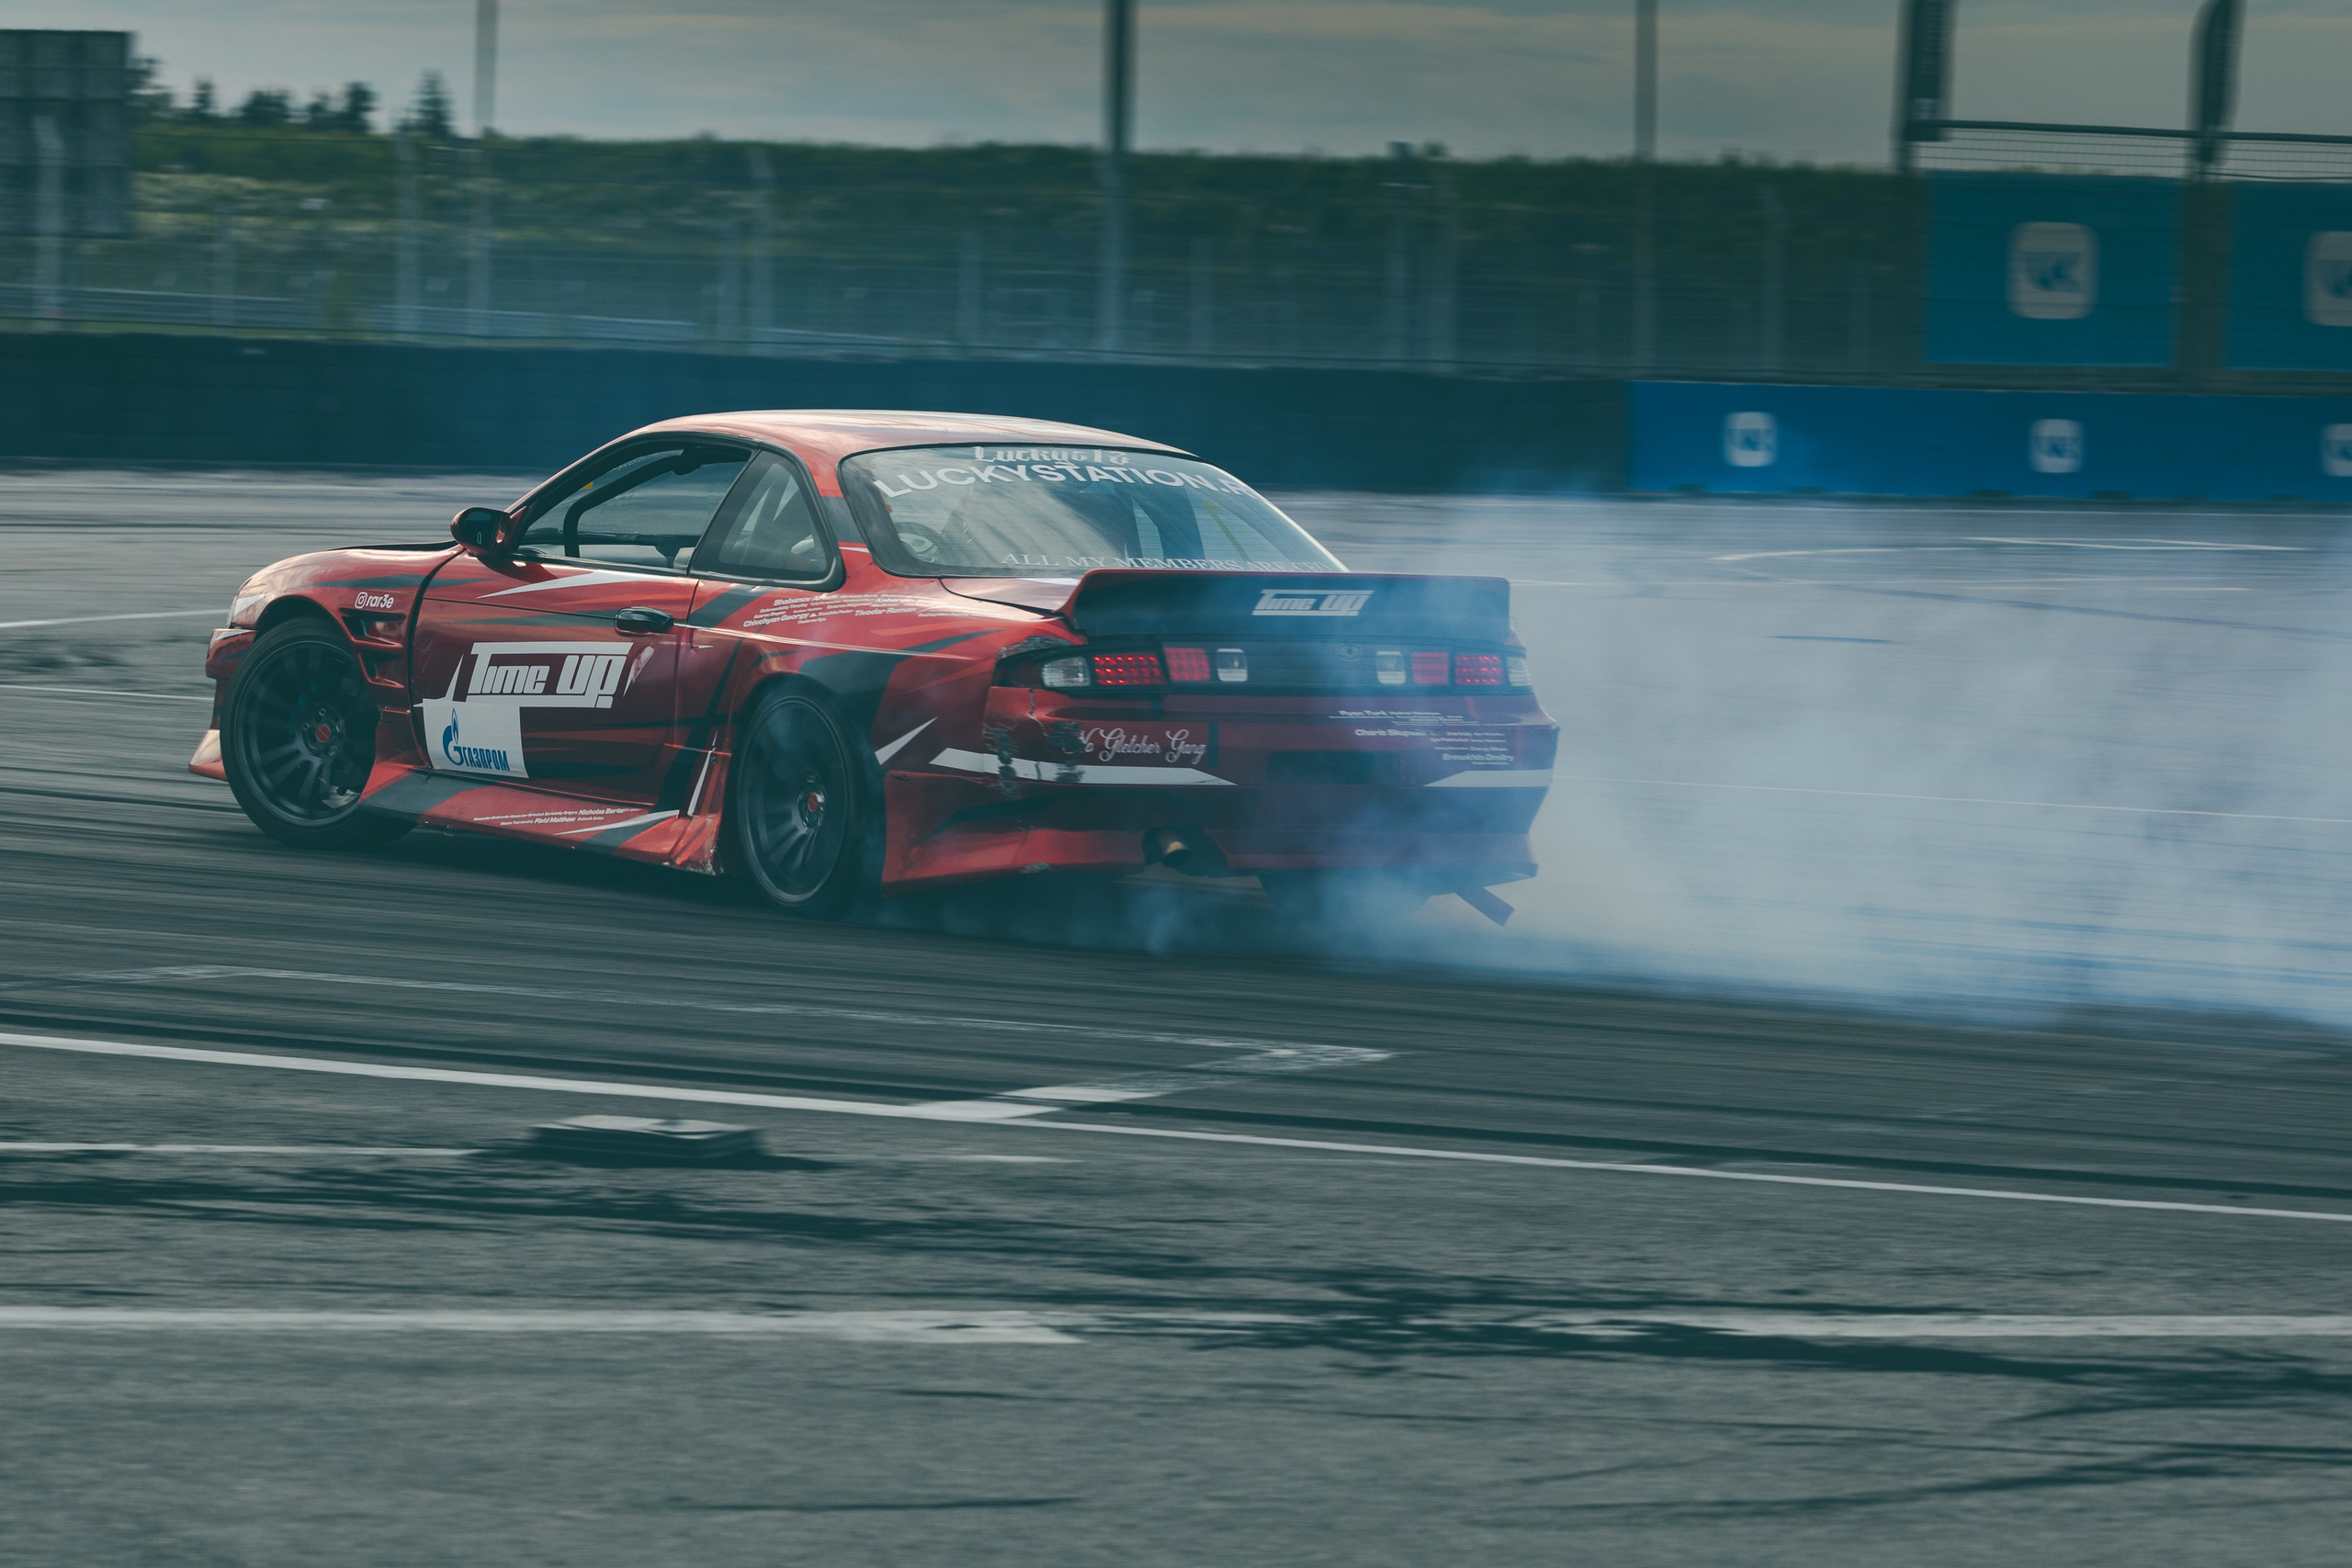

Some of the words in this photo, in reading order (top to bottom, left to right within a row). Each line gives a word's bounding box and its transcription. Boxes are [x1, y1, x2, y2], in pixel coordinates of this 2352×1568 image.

[1000, 553, 1059, 567] ALL
[1063, 556, 1108, 568] MY
[1111, 557, 1243, 570] MEMBERS
[1246, 561, 1288, 572] ARE
[461, 746, 511, 772] ГАЗПРОМ
